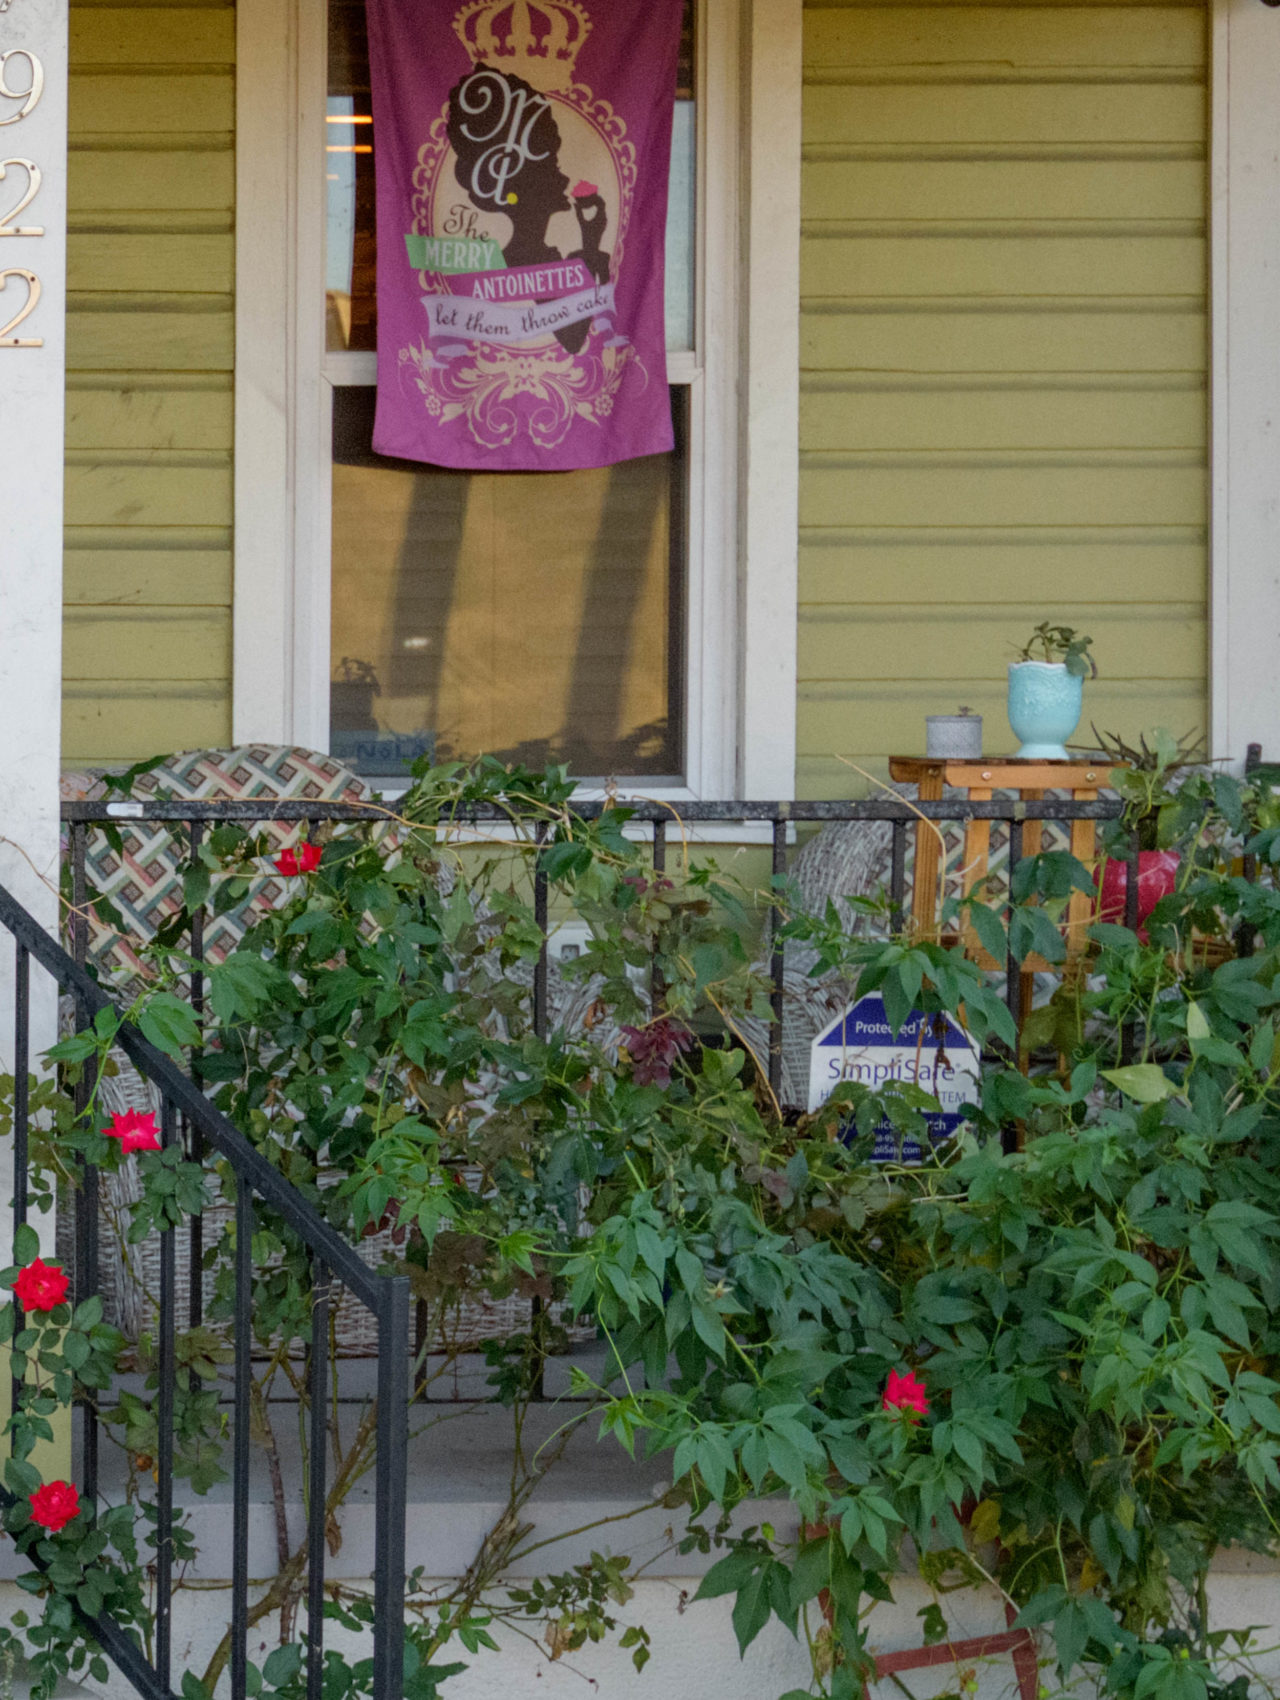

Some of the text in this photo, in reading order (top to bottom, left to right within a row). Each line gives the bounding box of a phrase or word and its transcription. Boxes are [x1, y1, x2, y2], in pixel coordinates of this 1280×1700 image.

[443, 204, 490, 244] The
[425, 239, 496, 270] MERRY
[472, 264, 585, 301] ANTOINETTES
[435, 303, 457, 326] let
[465, 310, 511, 336] them
[521, 305, 569, 334] throw
[855, 1020, 916, 1035] Proteced
